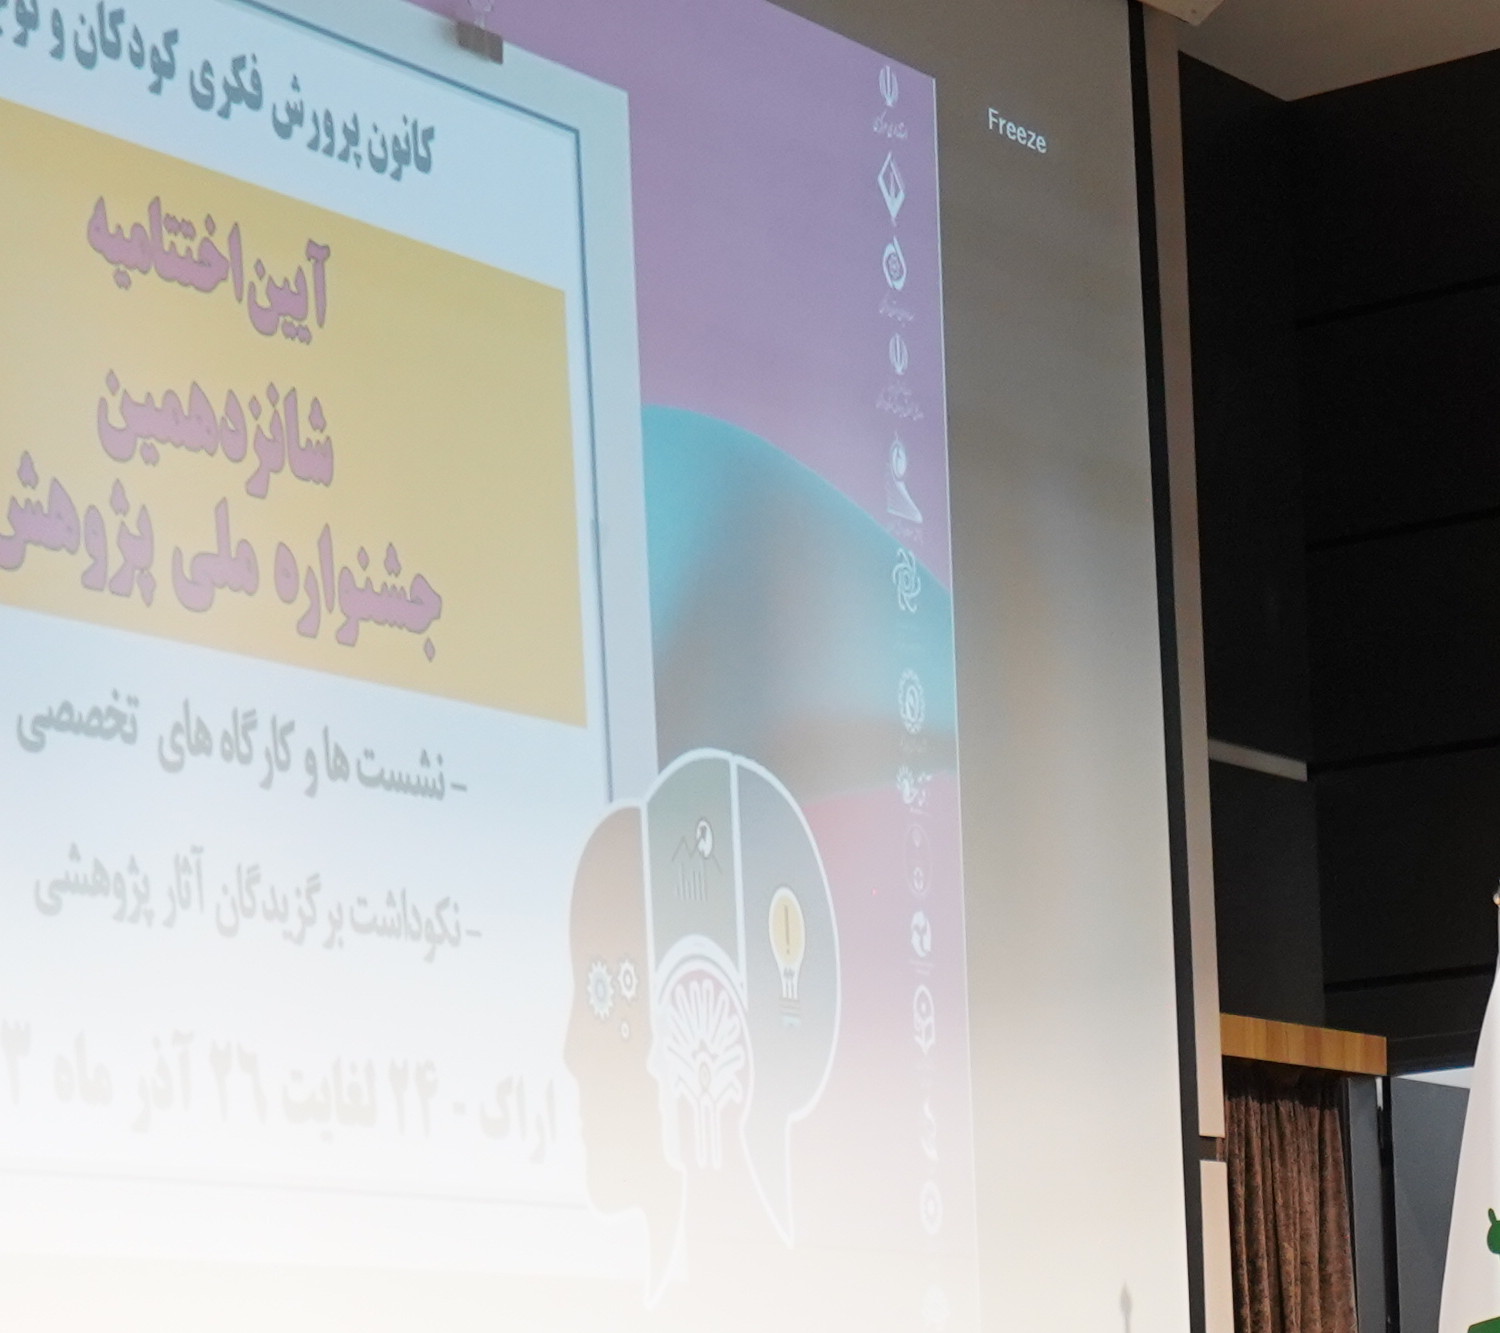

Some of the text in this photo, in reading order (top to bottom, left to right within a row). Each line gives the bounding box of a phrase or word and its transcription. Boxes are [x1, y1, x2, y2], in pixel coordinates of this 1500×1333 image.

[48, 8, 66, 60] و
[73, 1, 179, 95] کودکان
[190, 53, 264, 120] فکری
[271, 74, 363, 169] پرورش
[367, 114, 436, 183] کانون
[987, 106, 1048, 154] Freeze
[86, 195, 331, 346] آیین اختتامیه
[97, 367, 335, 500] شانزدهمین
[171, 495, 261, 614] ملی
[273, 522, 443, 664] جشنواره
[15, 688, 140, 754] تخصصی
[157, 699, 214, 774] های
[304, 750, 318, 798] و
[33, 842, 156, 929] پژوهشی
[162, 847, 206, 930] آثار
[51, 1030, 114, 1106] ماه
[129, 1029, 196, 1135] آذر
[479, 1076, 558, 1164] اراک
